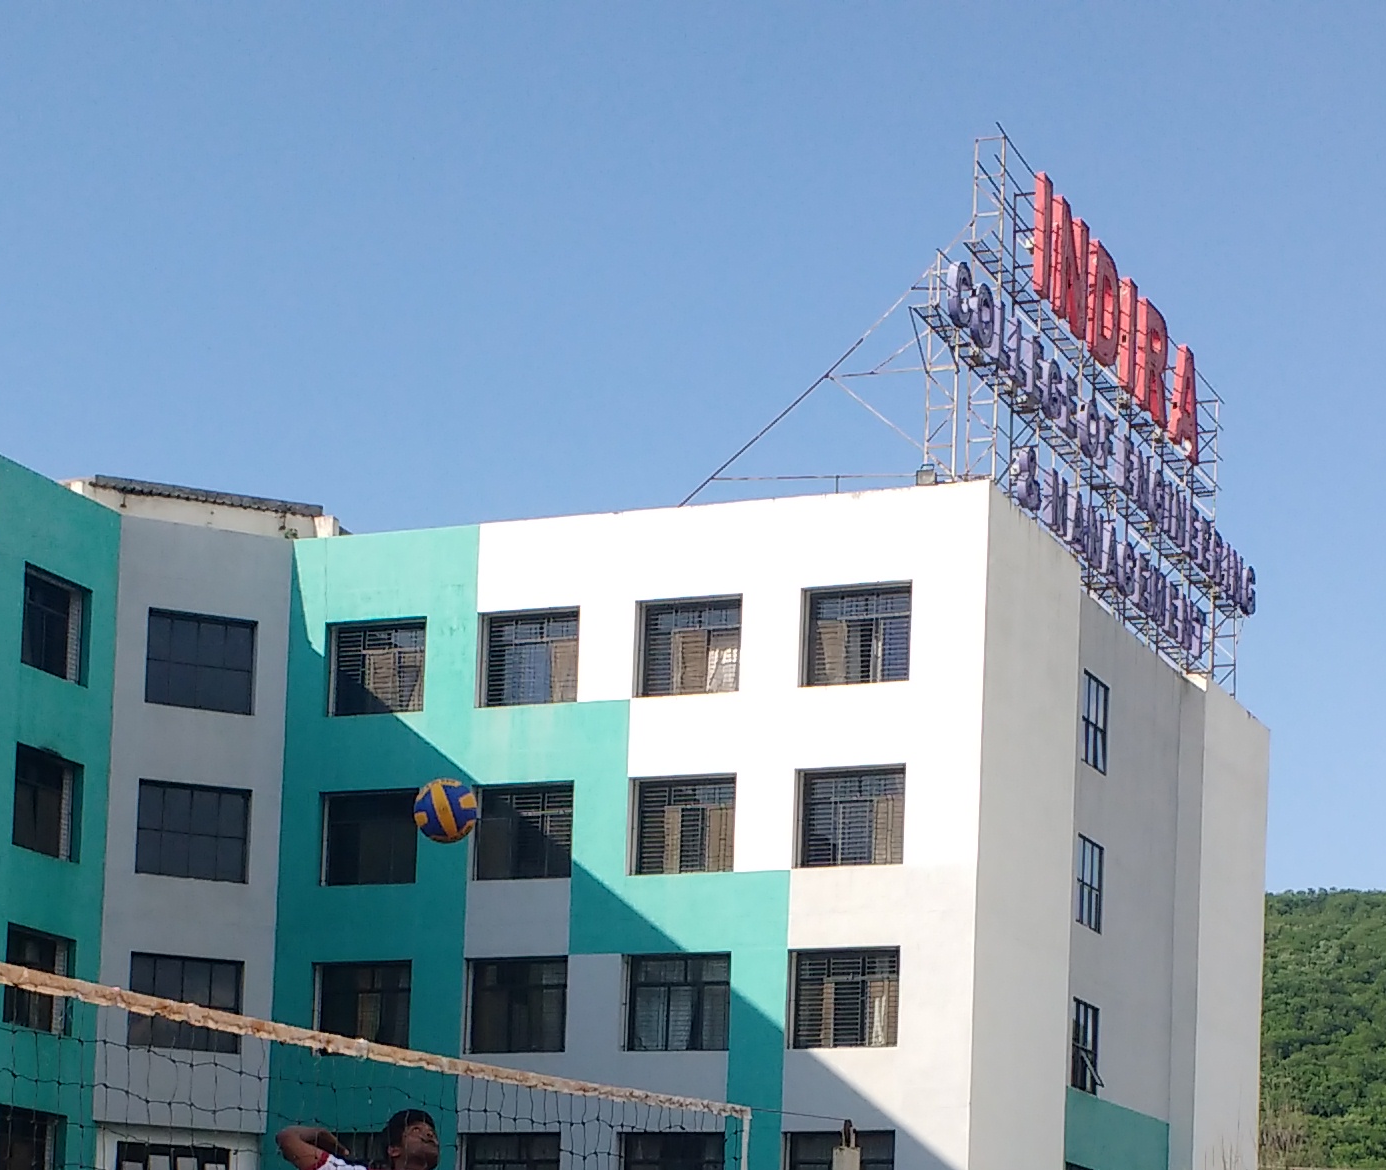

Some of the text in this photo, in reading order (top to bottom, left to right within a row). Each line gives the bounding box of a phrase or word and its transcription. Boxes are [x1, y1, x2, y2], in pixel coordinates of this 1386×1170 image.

[946, 261, 1256, 618] COLLEGE OF ENGINEERING
[1032, 171, 1199, 466] INDIRA
[1016, 446, 1207, 660] & MANAGEMENT
